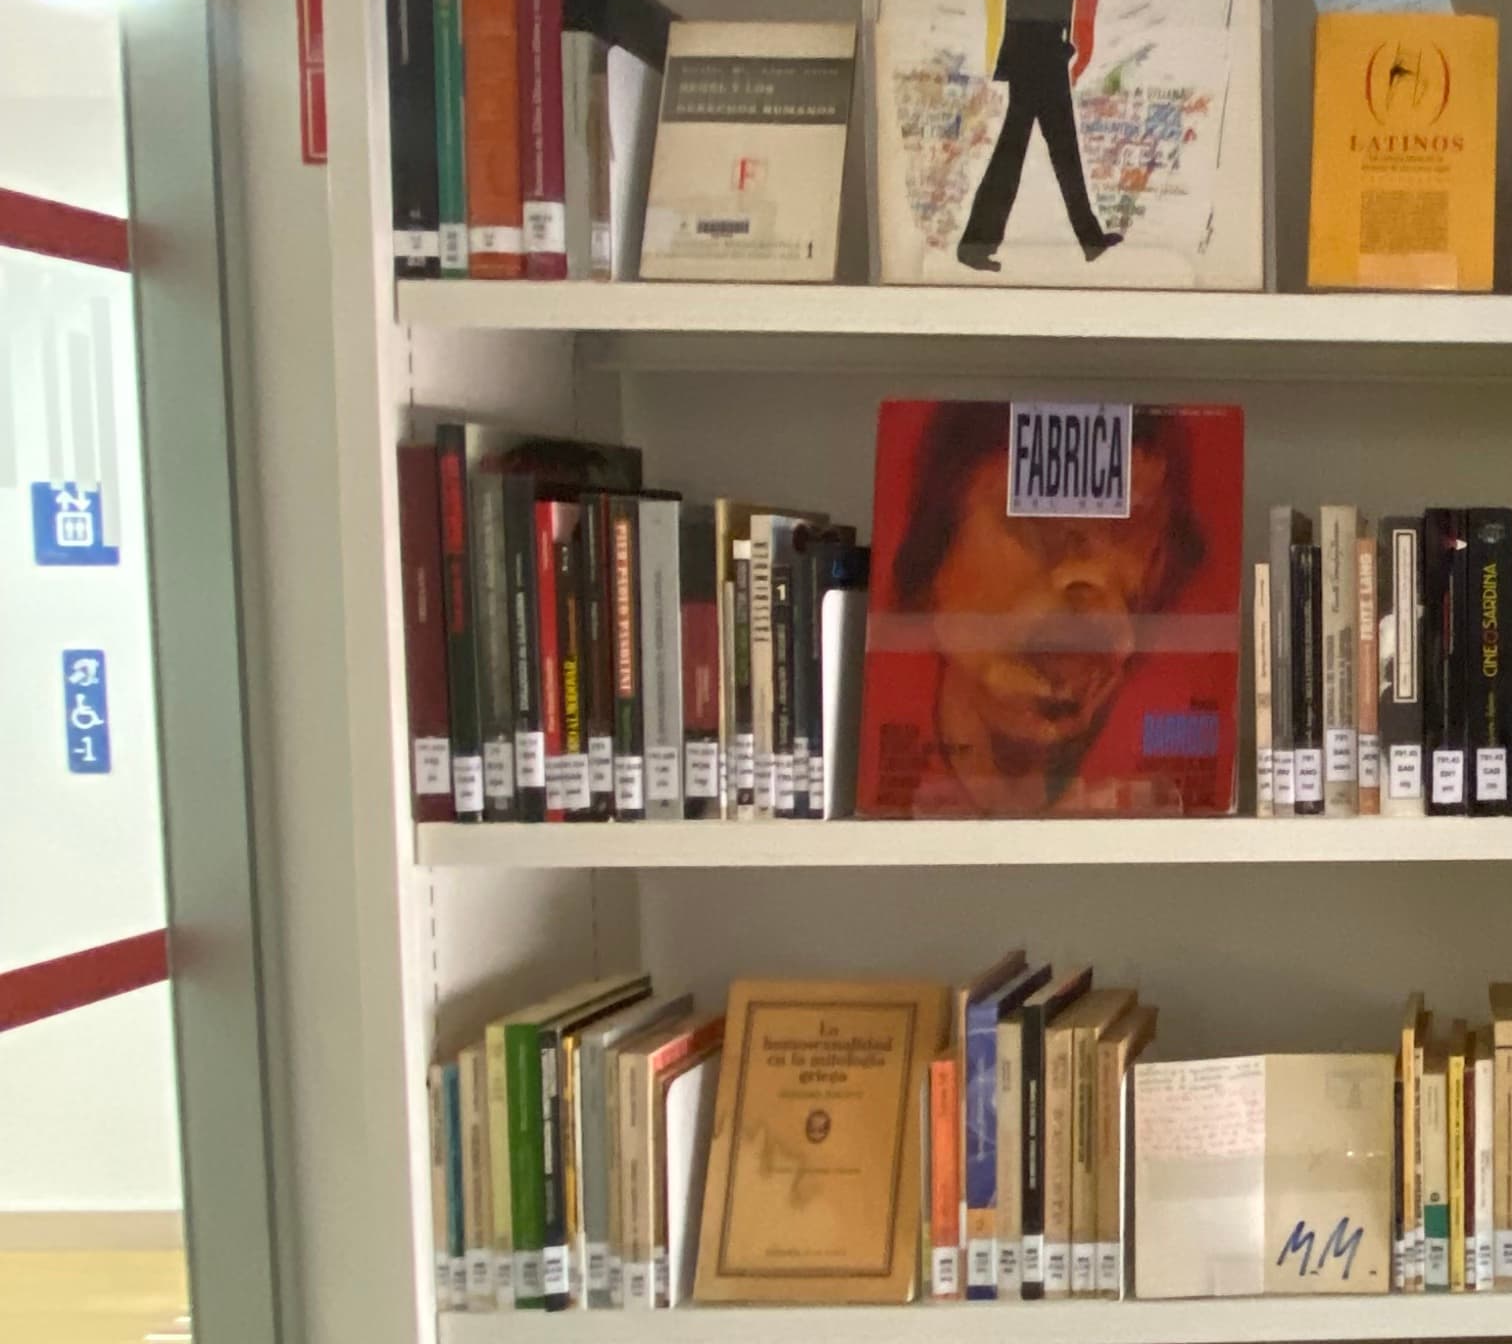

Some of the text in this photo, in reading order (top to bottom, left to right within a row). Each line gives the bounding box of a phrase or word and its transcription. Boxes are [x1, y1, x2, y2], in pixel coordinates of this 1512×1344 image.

[1350, 135, 1464, 152] LATINOS
[1014, 413, 1123, 499] FABRICA
[1360, 553, 1373, 593] LANG
[1482, 563, 1498, 629] SARDINA
[1482, 644, 1498, 677] CINE
[73, 737, 97, 762] -1
[819, 1020, 839, 1035] La
[763, 1036, 893, 1051] homosexualidad
[798, 1068, 848, 1085] griega
